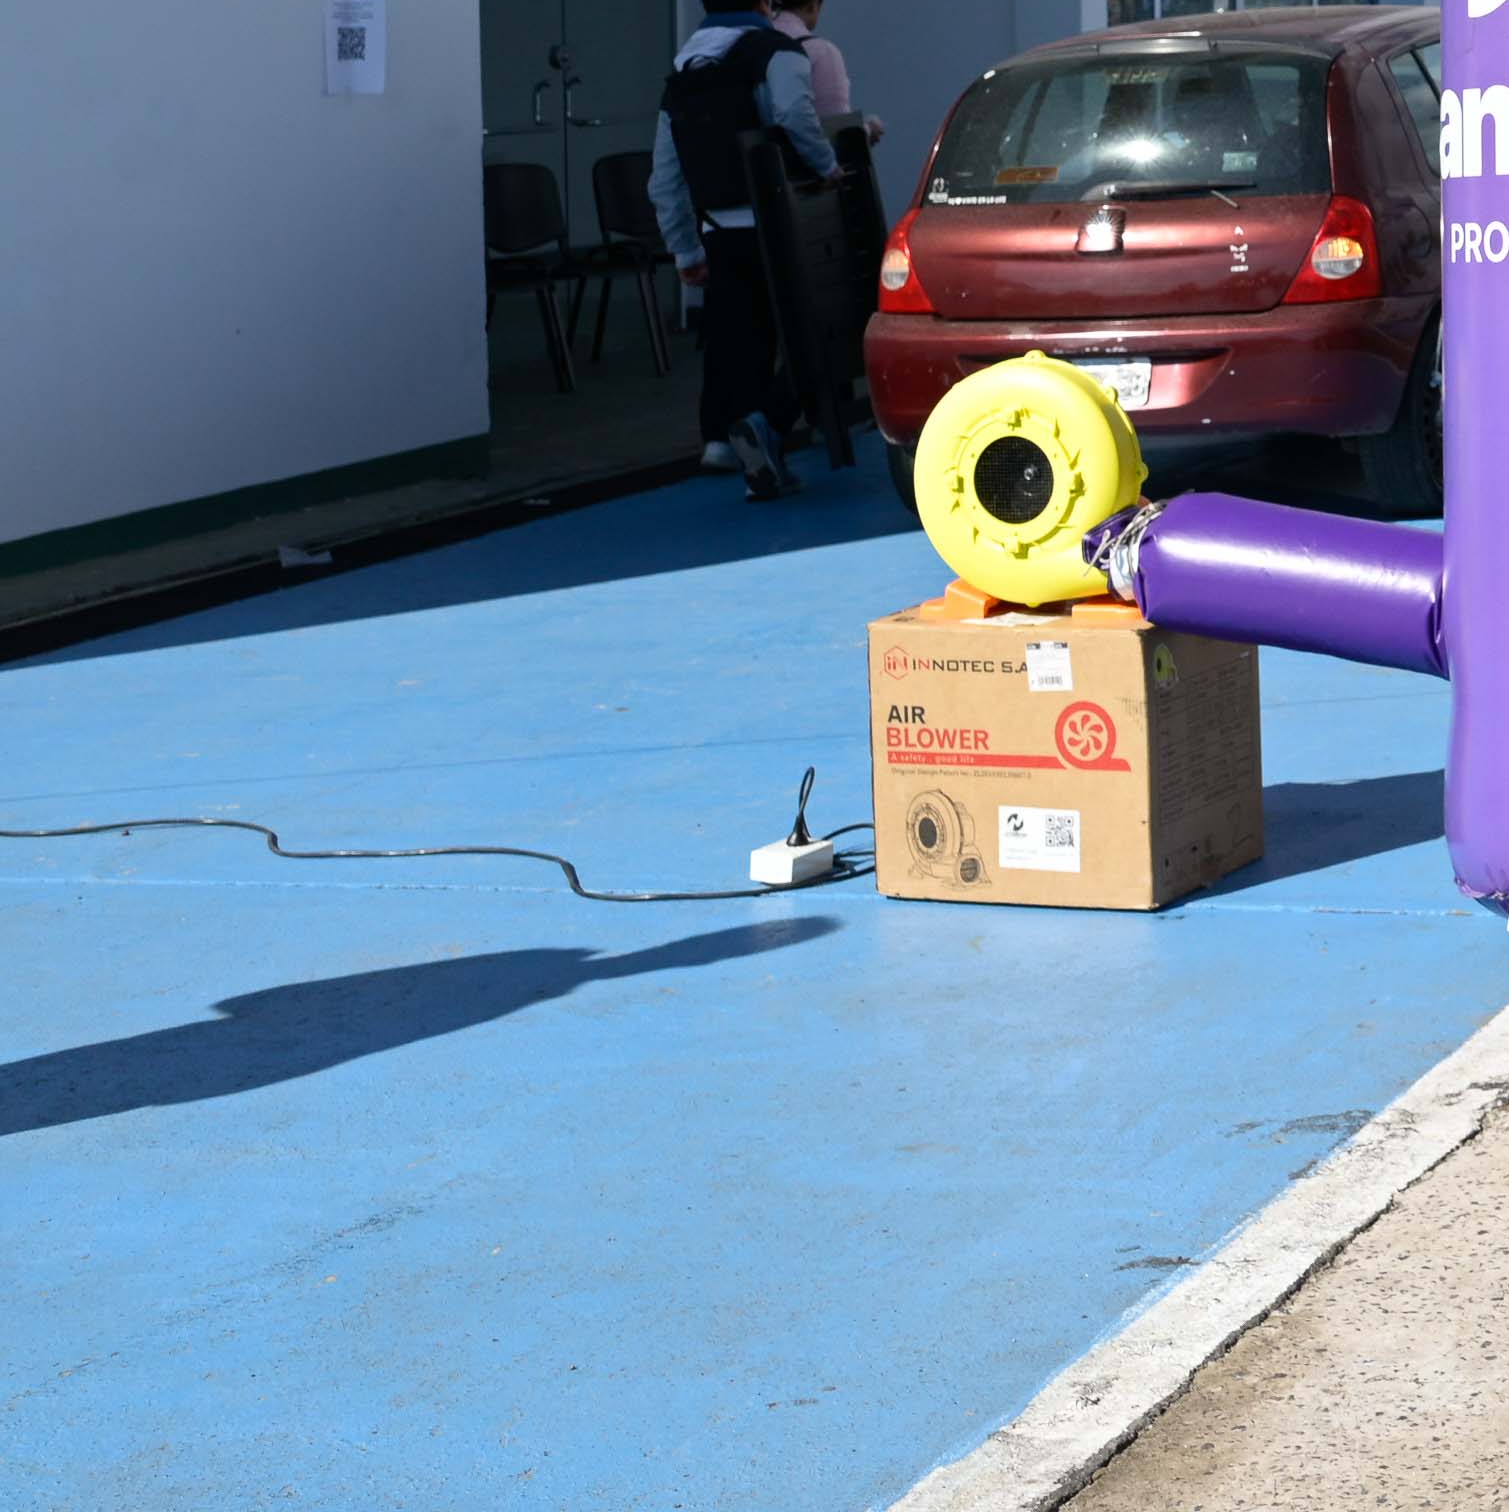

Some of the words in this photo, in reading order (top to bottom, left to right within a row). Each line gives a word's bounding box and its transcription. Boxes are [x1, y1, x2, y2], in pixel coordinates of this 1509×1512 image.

[912, 659, 996, 674] INNOTEC
[887, 705, 926, 724] AIR
[886, 727, 990, 751] BLOWER
